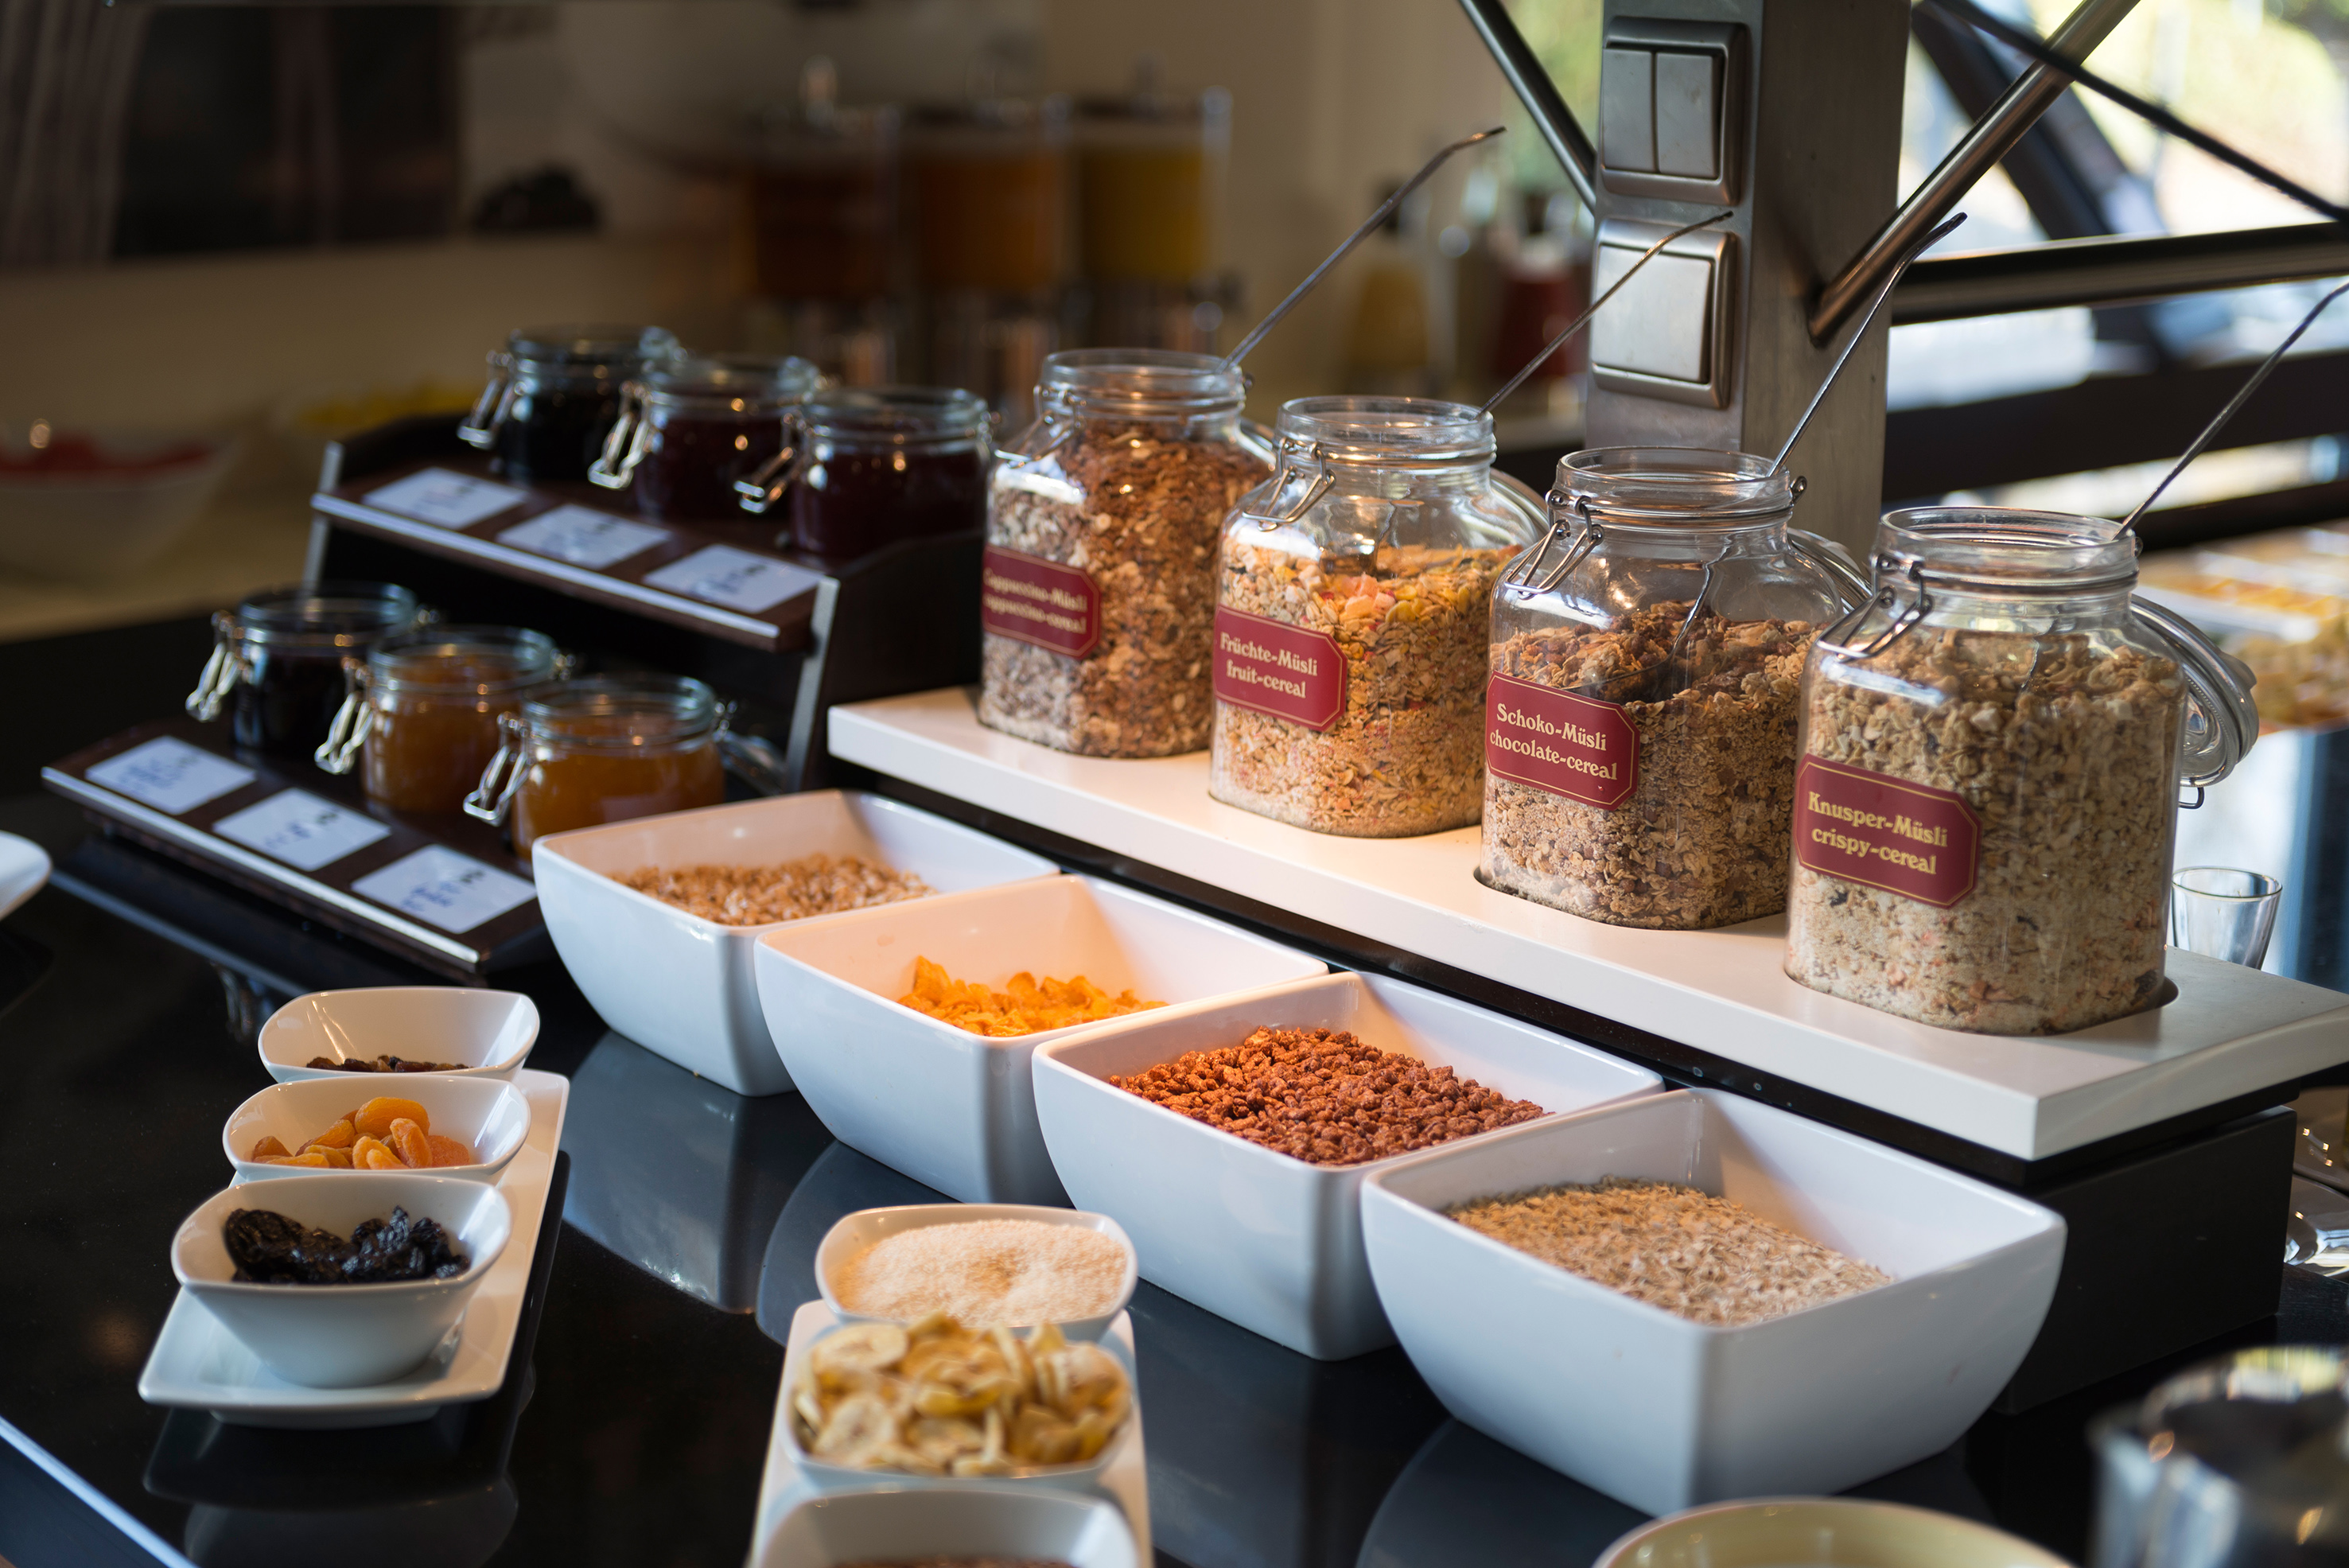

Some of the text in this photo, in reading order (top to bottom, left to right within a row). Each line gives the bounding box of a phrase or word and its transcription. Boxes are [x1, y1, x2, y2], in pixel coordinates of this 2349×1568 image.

[1220, 632, 1317, 676] Früchte-Müsli
[1227, 659, 1306, 698] fruit-cereal
[1496, 703, 1607, 751] Schoko-Müsli
[1490, 729, 1617, 780] chocolate-cereal
[1808, 791, 1947, 847] Knusper-Müsli
[1811, 828, 1937, 875] crispy-cereal
